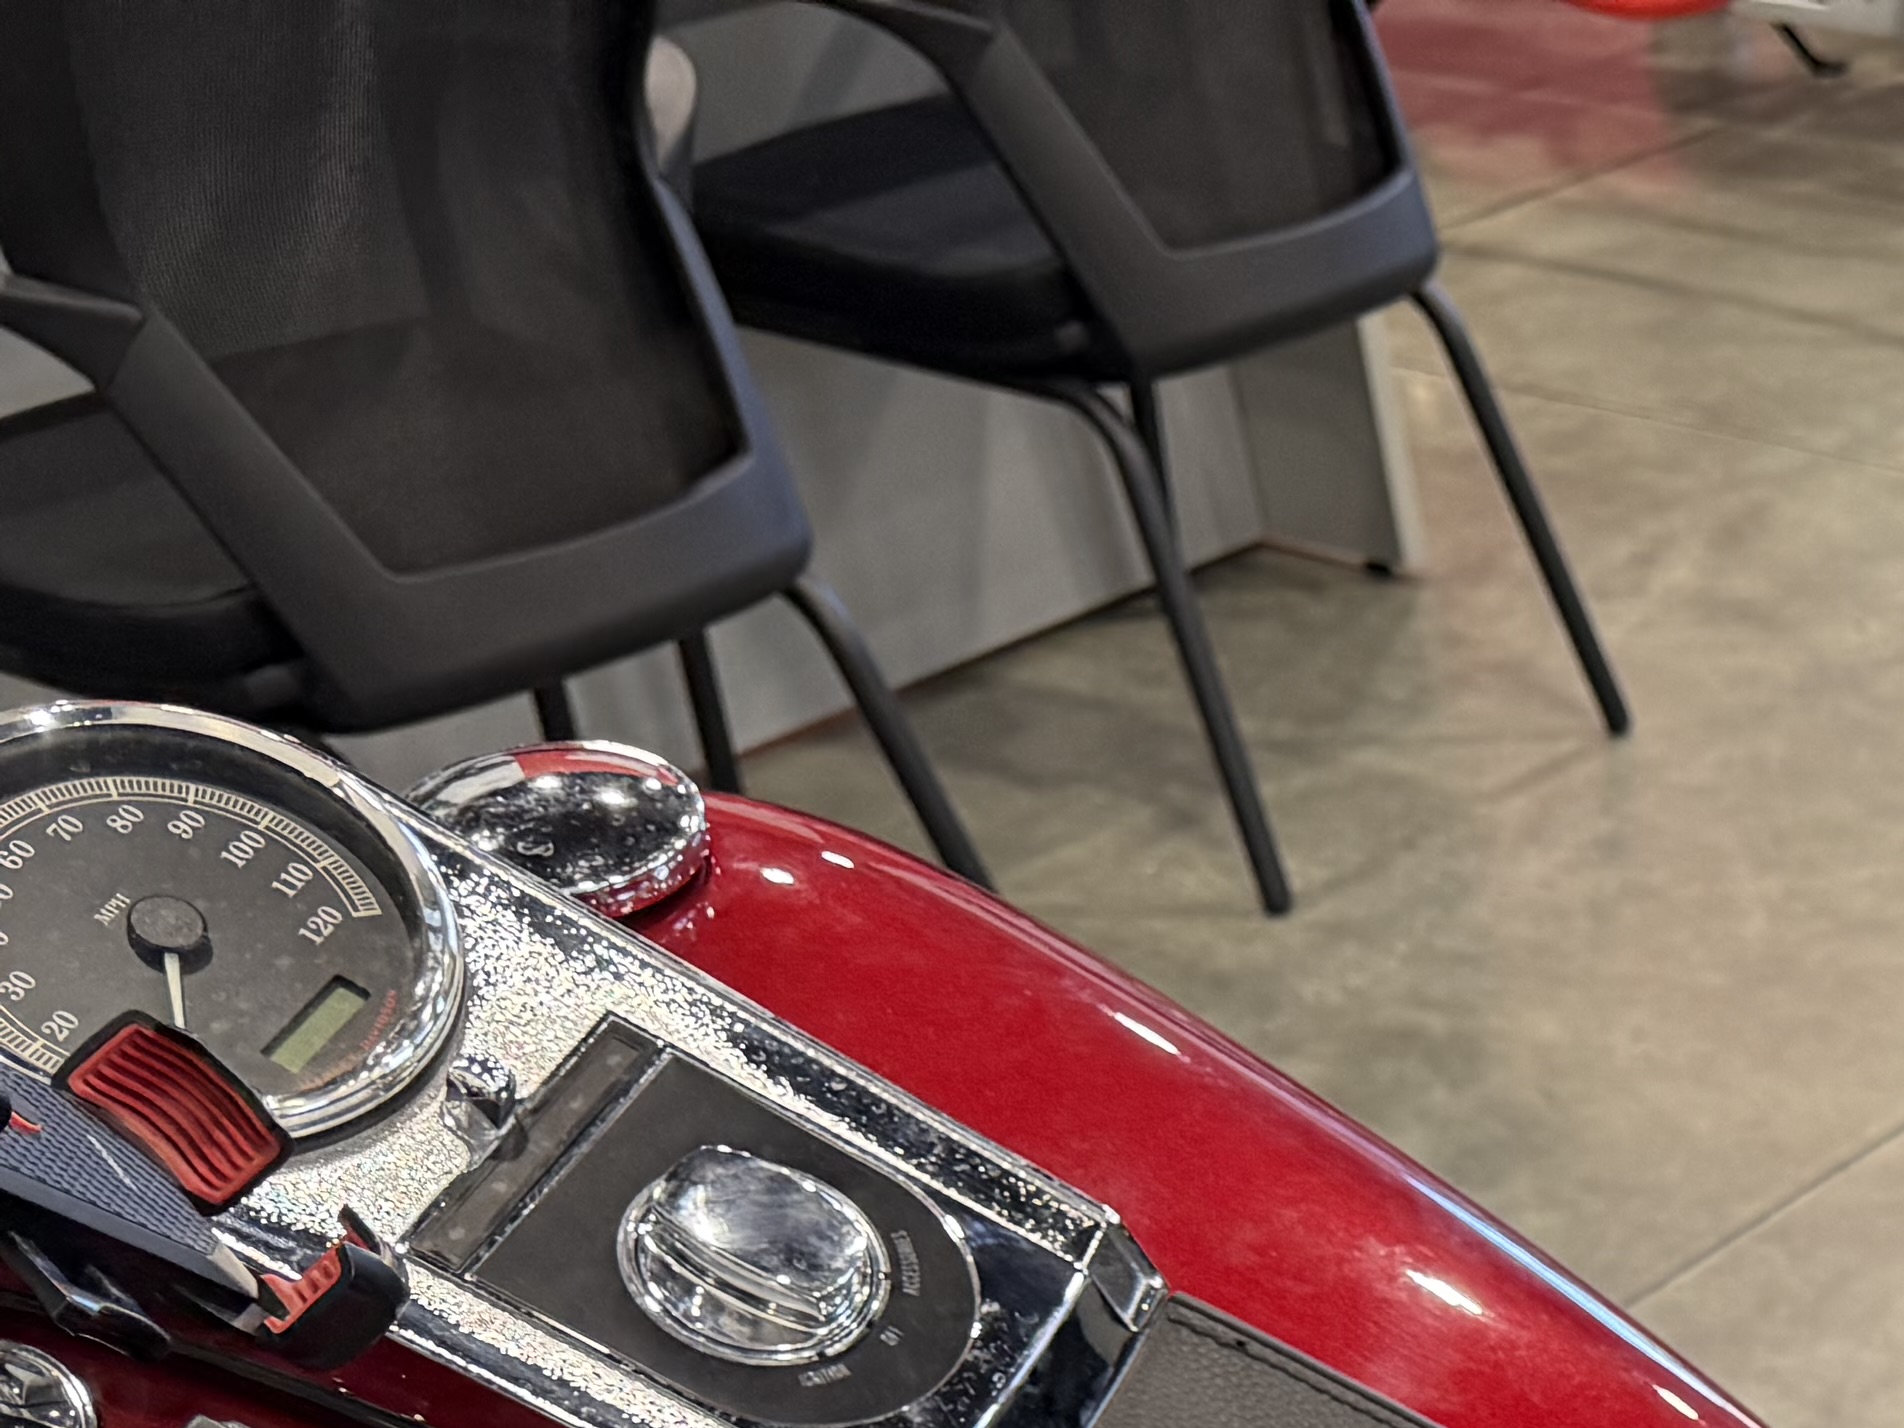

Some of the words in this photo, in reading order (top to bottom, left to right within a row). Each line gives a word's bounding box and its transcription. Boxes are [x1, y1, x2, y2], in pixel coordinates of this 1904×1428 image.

[45, 814, 84, 842] 70
[106, 804, 144, 834] 80
[167, 810, 206, 840] 90
[0, 839, 36, 870] 60
[220, 830, 266, 869] 100
[271, 862, 314, 898] 110
[93, 892, 131, 926] MPH
[298, 905, 343, 945] 120
[0, 970, 36, 1002] 30
[40, 1010, 80, 1043] 20
